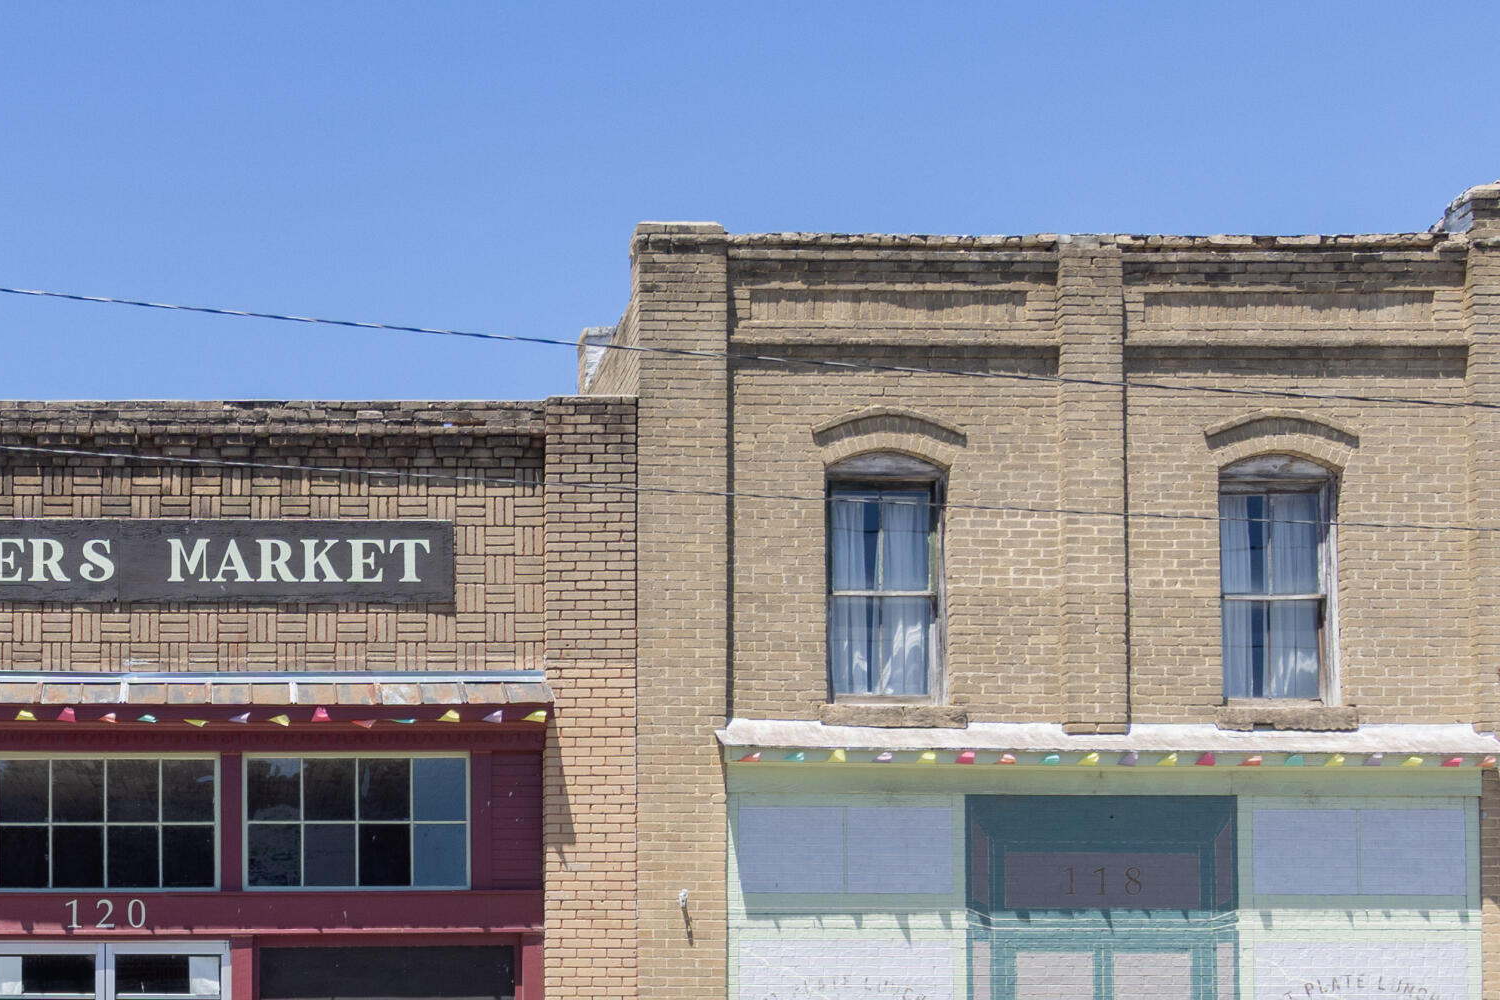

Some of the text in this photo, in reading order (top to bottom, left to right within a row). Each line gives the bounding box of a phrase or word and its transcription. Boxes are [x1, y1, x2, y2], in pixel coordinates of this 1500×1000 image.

[166, 537, 432, 584] MARKET
[1063, 866, 1143, 896] 118
[64, 898, 146, 929] 120
[1303, 974, 1366, 998] PLATE
